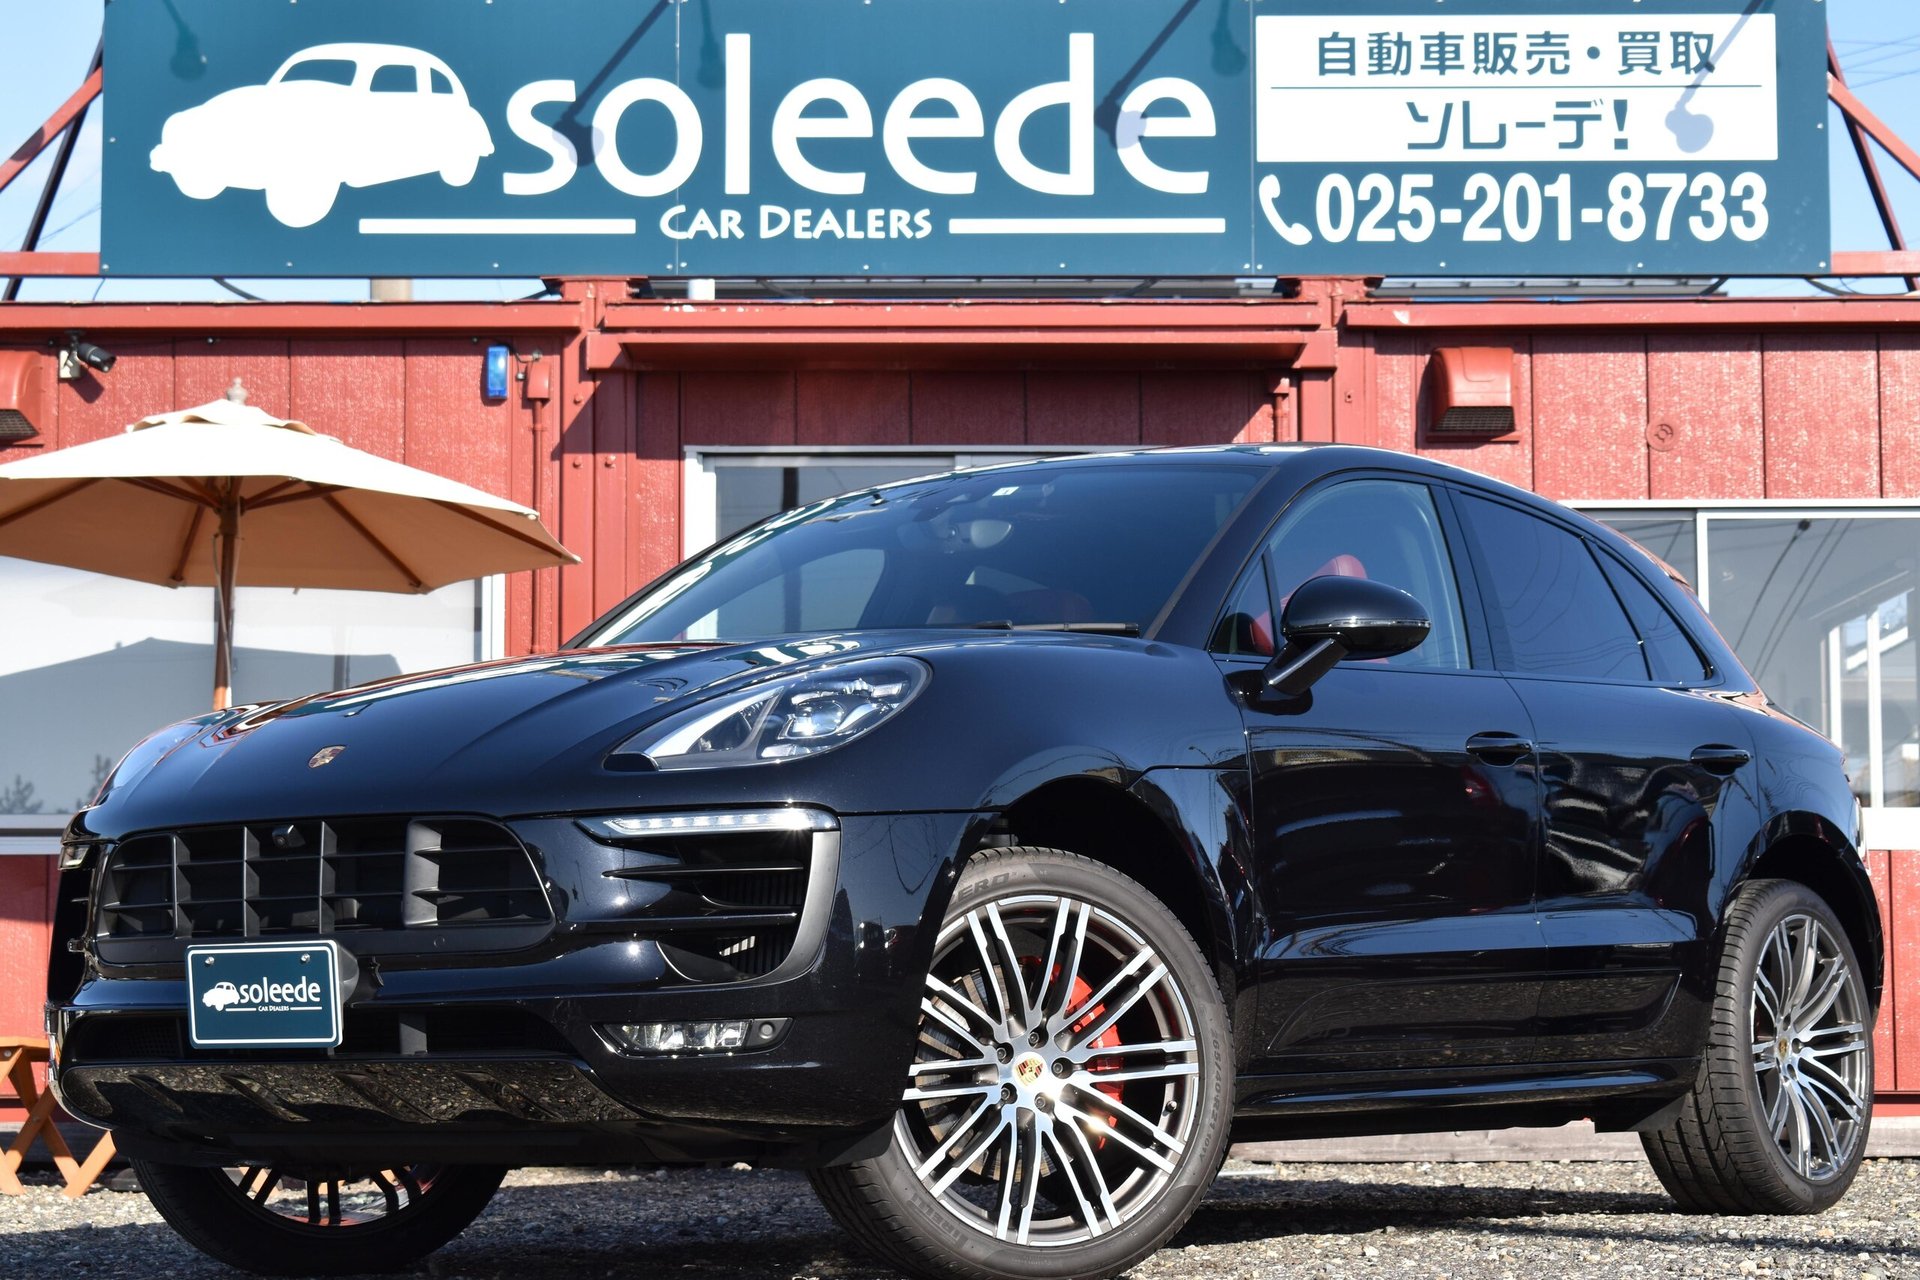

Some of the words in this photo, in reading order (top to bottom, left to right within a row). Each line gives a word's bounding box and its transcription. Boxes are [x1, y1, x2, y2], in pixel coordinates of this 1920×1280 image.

[1318, 31, 1714, 76] 自動車販売・買取
[503, 32, 1217, 196] soleede
[659, 204, 745, 240] CAR
[759, 204, 932, 240] DEALERS
[1315, 171, 1769, 243] 025-201-8733
[239, 975, 321, 1004] soleede
